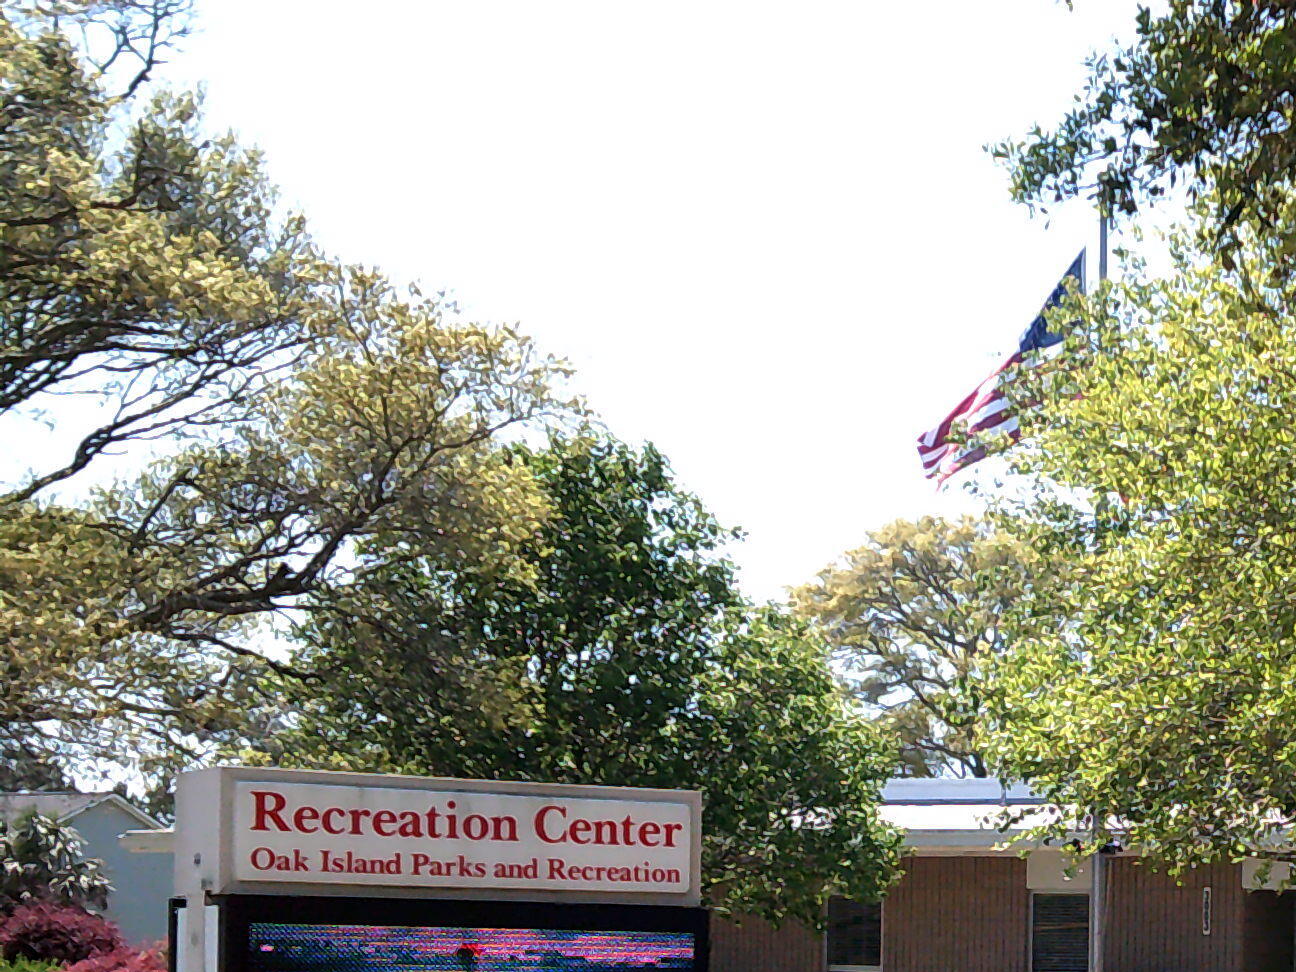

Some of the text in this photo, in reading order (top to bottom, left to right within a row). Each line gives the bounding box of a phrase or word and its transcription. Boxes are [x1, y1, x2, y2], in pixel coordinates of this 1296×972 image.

[250, 790, 683, 847] Recreation Center
[250, 847, 680, 883] Oak Island Parks and Recreation
